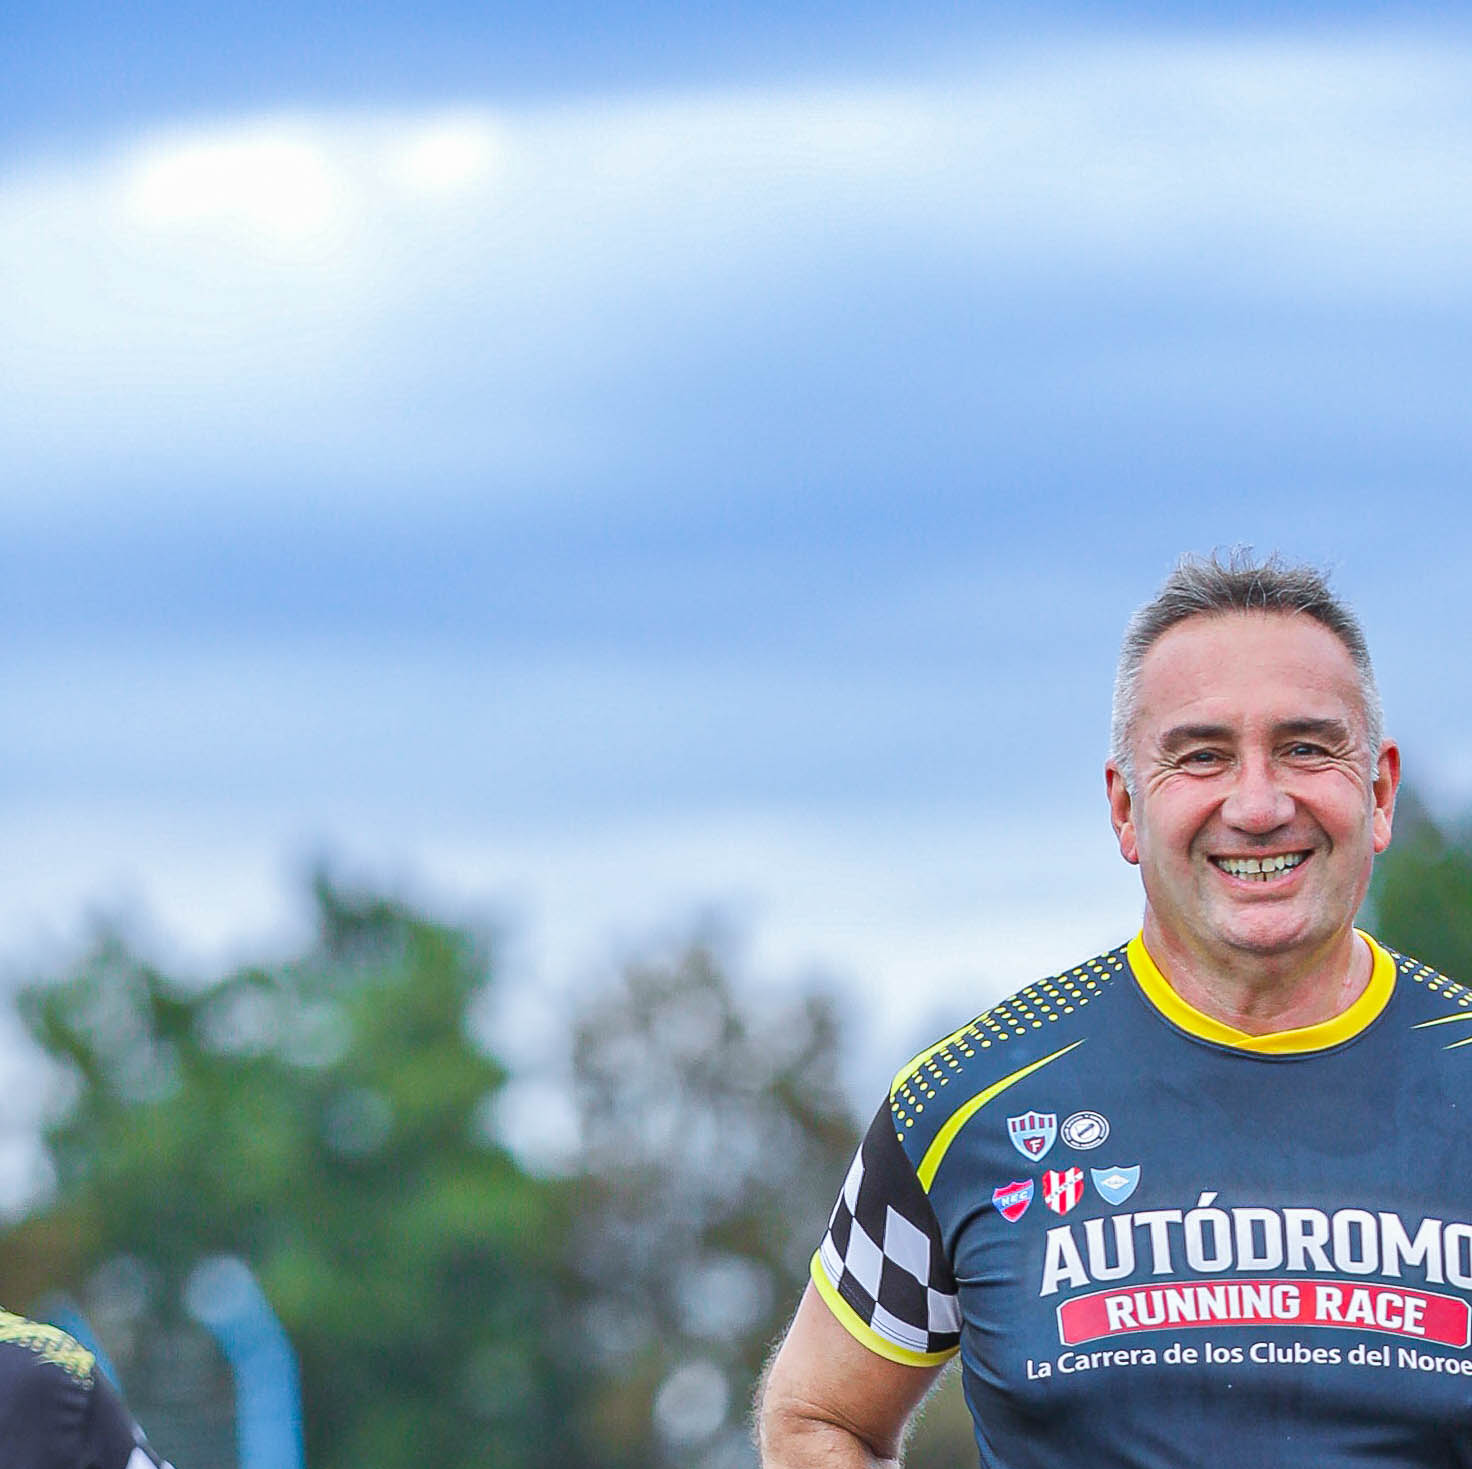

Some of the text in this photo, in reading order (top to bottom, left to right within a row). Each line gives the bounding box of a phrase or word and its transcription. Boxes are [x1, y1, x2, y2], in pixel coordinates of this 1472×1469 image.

[1104, 1284, 1428, 1336] RUNNING RACE
[1026, 1359, 1052, 1381] La
[1057, 1348, 1157, 1374] Carrera
[1163, 1342, 1198, 1364] de
[1205, 1342, 1244, 1364] los
[1249, 1342, 1342, 1364] Clubes
[1347, 1344, 1391, 1367] del
